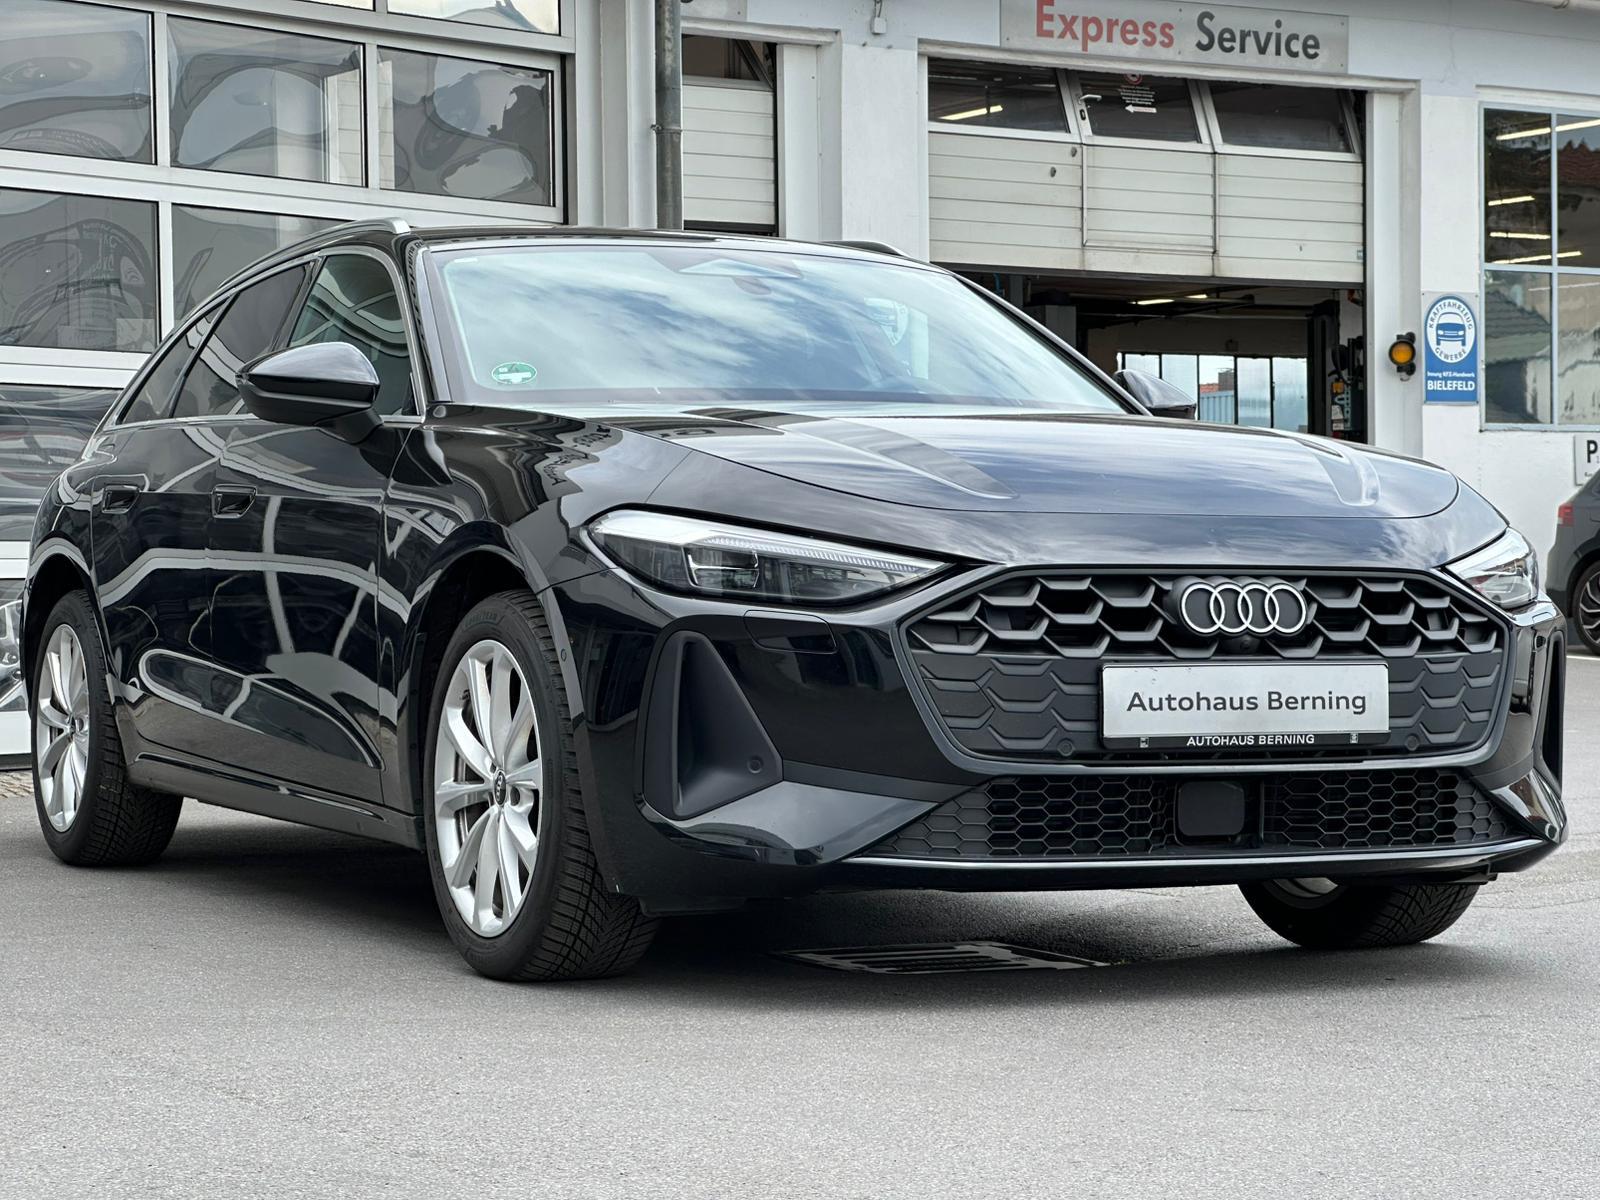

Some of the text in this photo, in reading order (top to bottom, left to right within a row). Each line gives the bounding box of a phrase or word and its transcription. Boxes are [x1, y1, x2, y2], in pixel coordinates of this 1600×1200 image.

[1036, 0, 1321, 60] Express Service
[1428, 301, 1473, 330] KRAFTFAHRZEUG
[1434, 347, 1467, 361] GEWERBE
[1427, 380, 1475, 391] BIELEFELD
[1126, 691, 1367, 715] Autohaus Berning
[1186, 734, 1315, 746] AUTOHAUS BERNING
